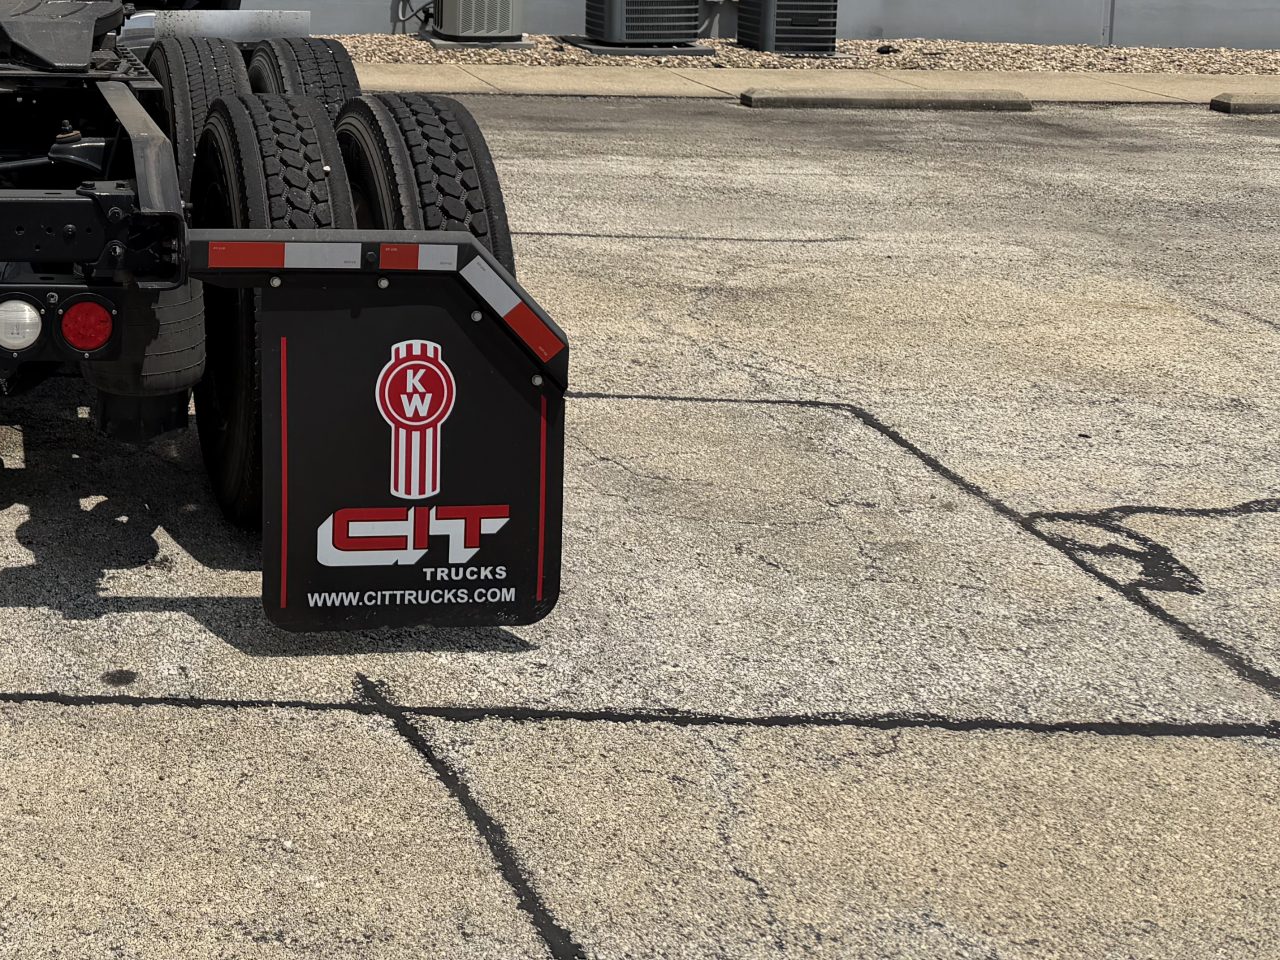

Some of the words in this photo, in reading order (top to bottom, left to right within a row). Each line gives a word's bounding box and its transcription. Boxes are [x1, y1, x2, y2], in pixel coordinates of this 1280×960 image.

[317, 504, 510, 567] CIT
[423, 565, 508, 581] TRUCKS
[307, 587, 516, 608] WWW.CITTRUCKS.COM
